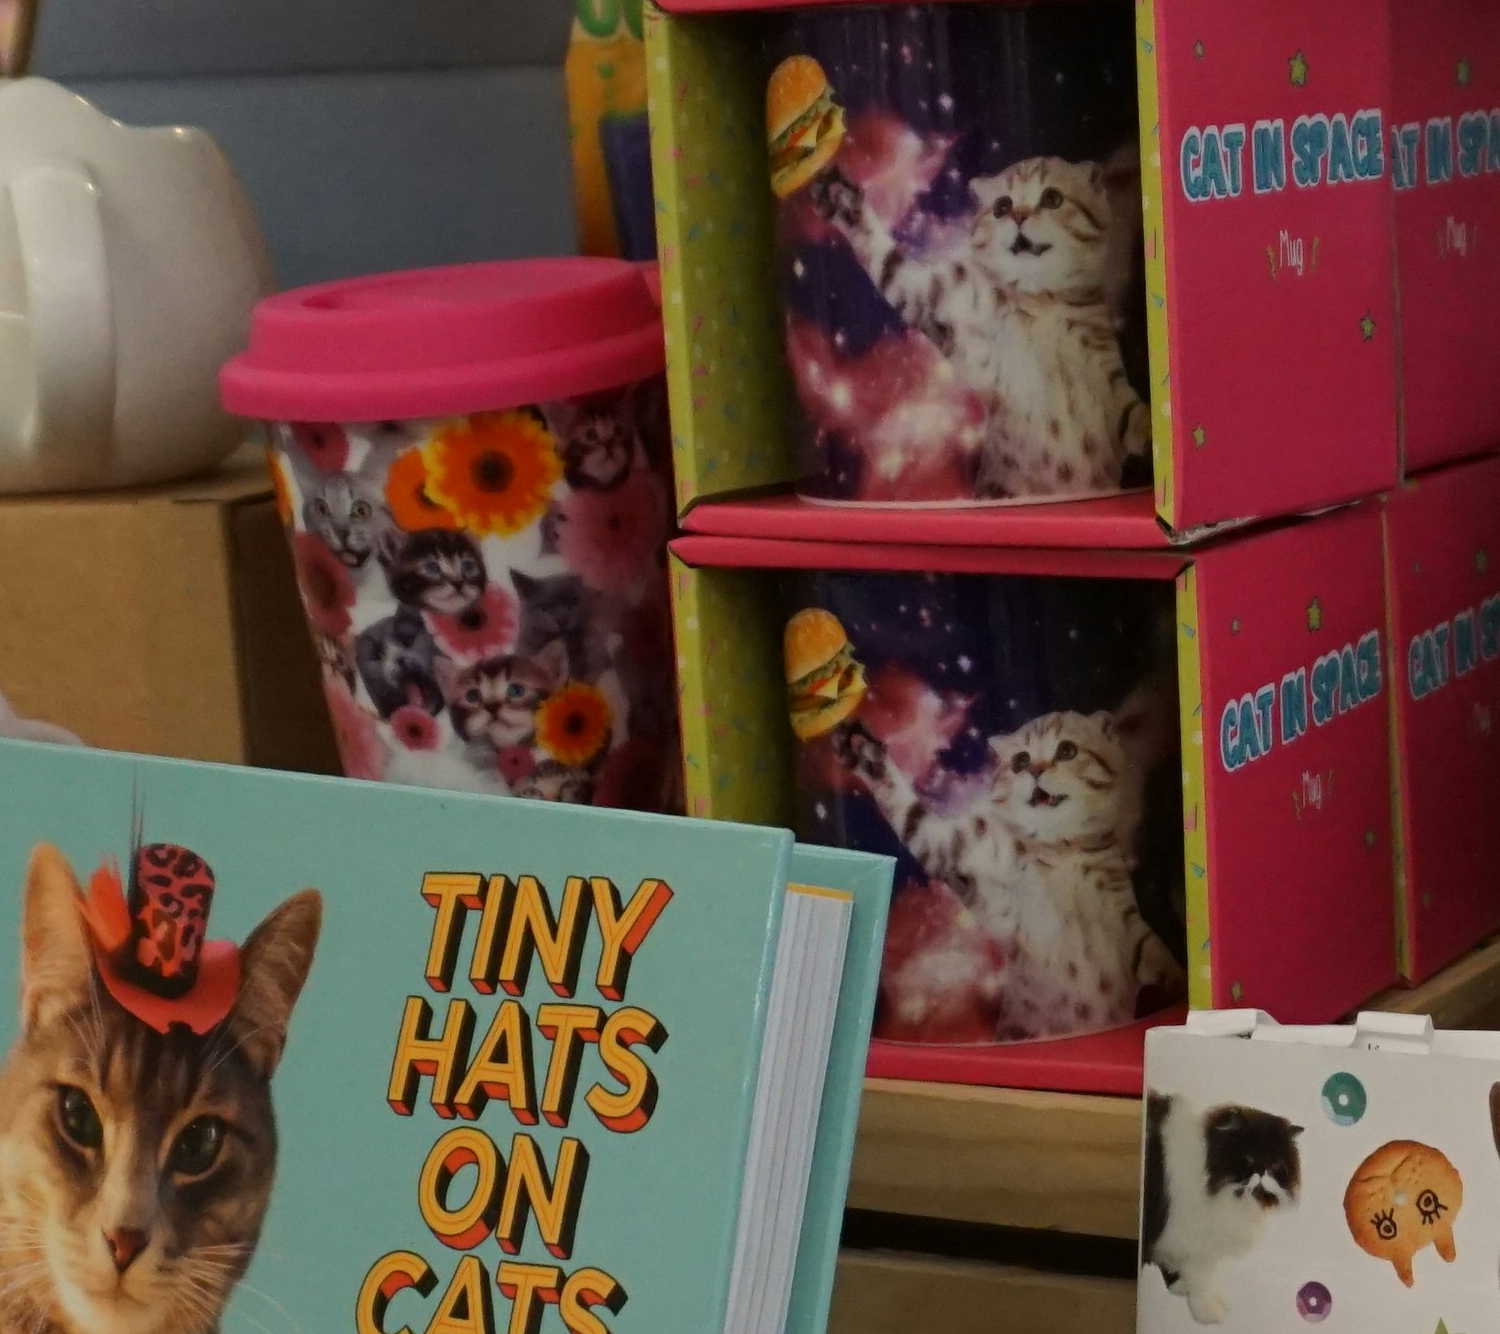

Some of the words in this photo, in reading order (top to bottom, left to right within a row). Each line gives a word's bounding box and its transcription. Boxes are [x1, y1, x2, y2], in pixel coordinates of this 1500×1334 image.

[1181, 124, 1246, 204] CAT
[1252, 118, 1287, 196] IN
[1293, 107, 1387, 189] SPACE
[421, 871, 674, 1001] TINY
[387, 995, 669, 1134] HATS
[418, 1125, 593, 1261] ON
